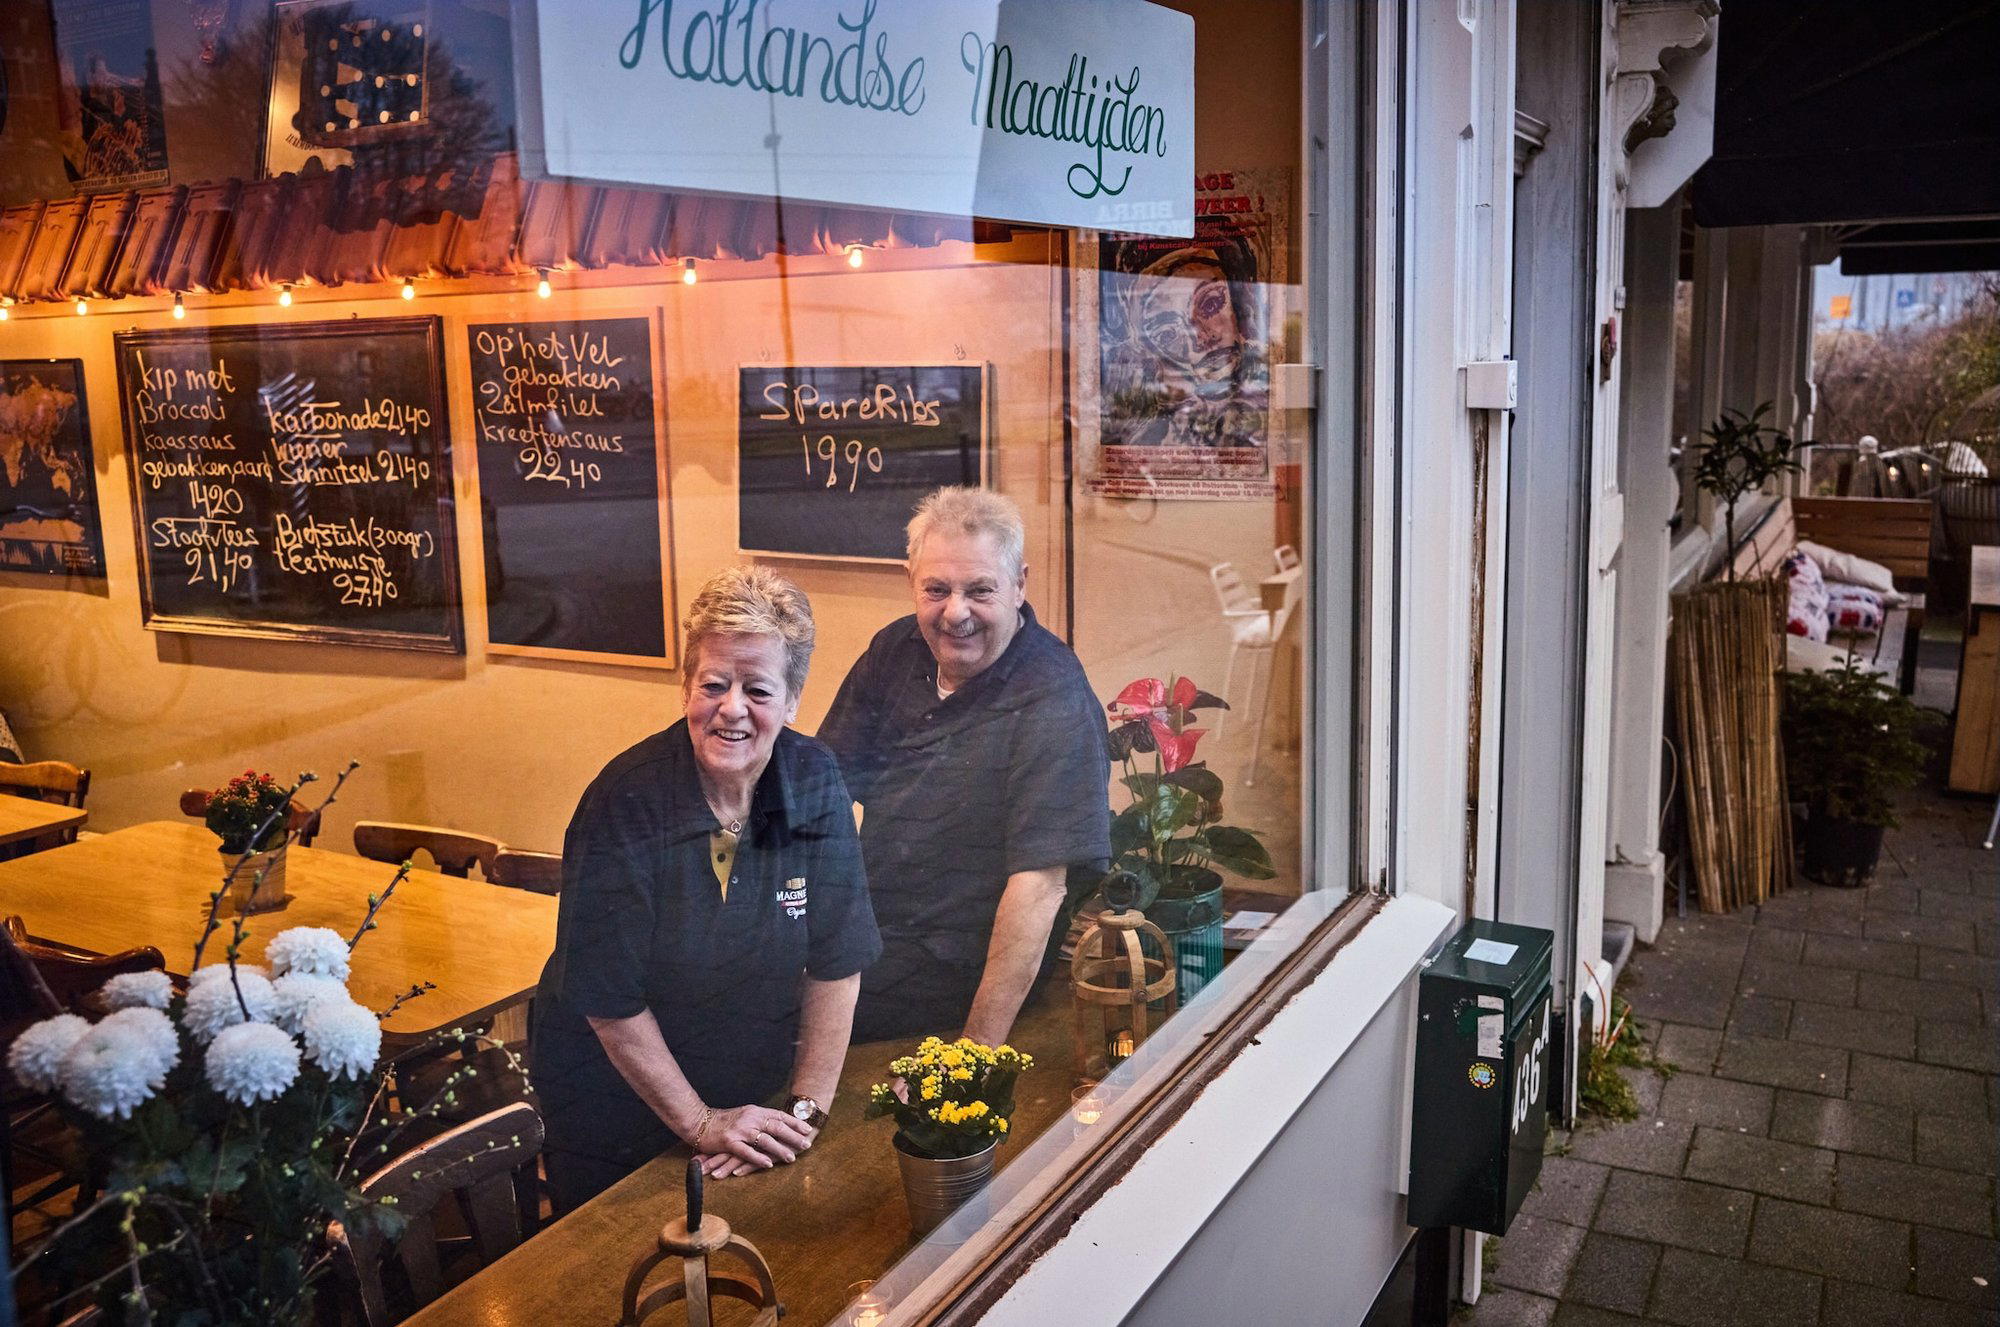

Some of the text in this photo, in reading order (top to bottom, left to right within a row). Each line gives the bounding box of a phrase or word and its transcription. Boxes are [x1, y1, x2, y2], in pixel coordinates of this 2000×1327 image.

[619, 0, 1167, 199] Hollandse Maaltijden
[477, 331, 514, 367] Op
[518, 332, 569, 360] het
[185, 359, 236, 393] met
[503, 357, 620, 399] gebakken
[136, 389, 226, 424] Broccoli
[520, 448, 601, 489] 22,40
[185, 548, 253, 592] 21,40
